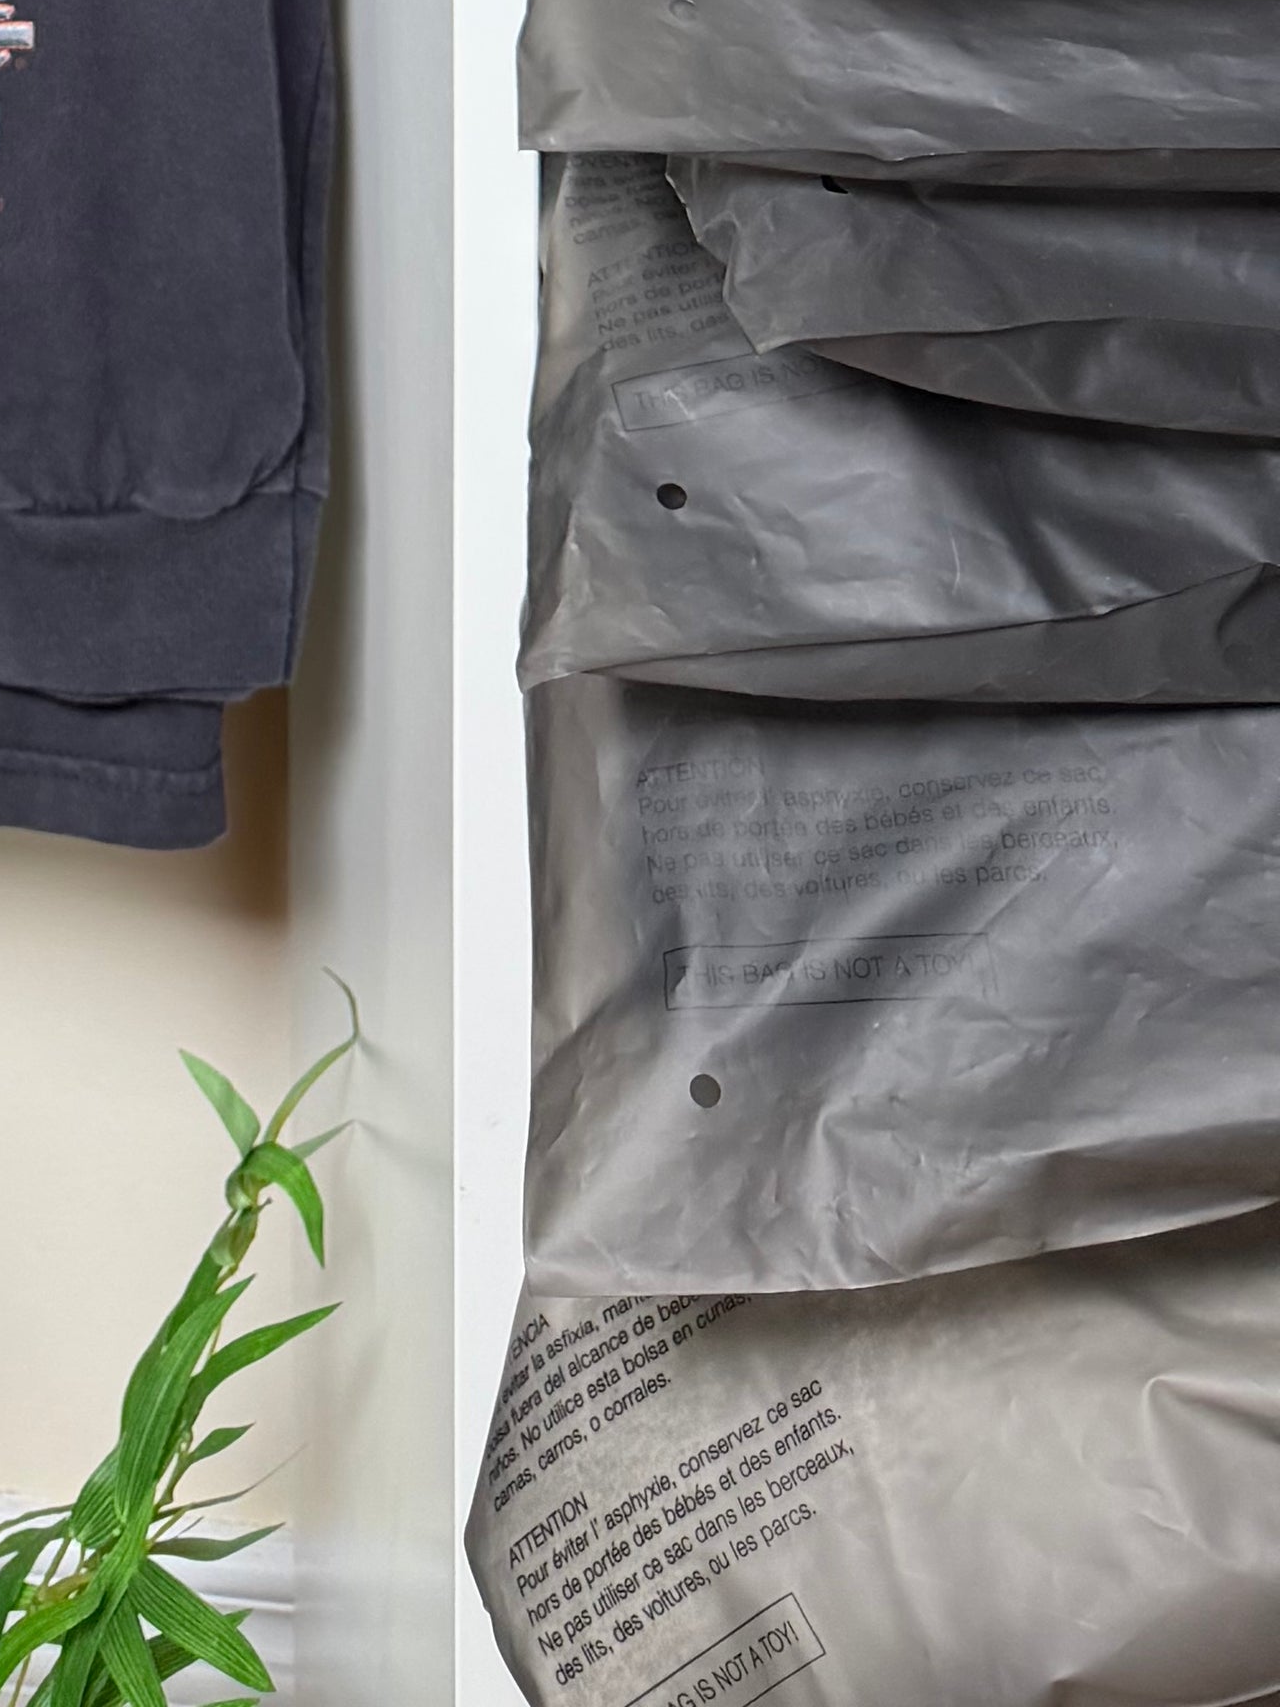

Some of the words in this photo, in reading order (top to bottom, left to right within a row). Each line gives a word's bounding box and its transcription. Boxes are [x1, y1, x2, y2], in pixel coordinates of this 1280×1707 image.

[597, 316, 626, 336] Ne
[633, 306, 671, 326] pas
[601, 333, 641, 352] des
[752, 366, 774, 385] IS
[815, 815, 857, 836] des
[863, 806, 935, 831] bébés
[941, 802, 961, 820] et
[1023, 795, 1116, 816] enfants.
[899, 769, 1015, 799] conservez
[1022, 766, 1052, 784] ce
[813, 848, 840, 865] ce
[848, 842, 887, 861] sac
[976, 863, 1049, 885] parcs.
[803, 960, 825, 980] IS
[834, 955, 883, 981] NOT
[895, 955, 911, 977] A
[510, 1394, 543, 1427] fuera
[543, 1373, 566, 1397] del
[566, 1333, 629, 1378] alcance
[632, 1311, 655, 1338] de
[520, 1424, 541, 1452] No
[543, 1391, 584, 1435] utilice
[587, 1371, 622, 1399] esta
[621, 1338, 669, 1378] bolsa
[671, 1323, 693, 1346] en
[695, 1294, 752, 1329] cunas,
[533, 1352, 545, 1373] la
[546, 1317, 600, 1360] asfixia,
[538, 1429, 588, 1471] carros,
[589, 1415, 601, 1433] o
[603, 1369, 672, 1422] corrales.
[516, 1561, 550, 1599] Pour
[553, 1531, 590, 1570] éviter
[604, 1473, 677, 1530] asphyxie,
[678, 1416, 765, 1479] conservez
[767, 1401, 789, 1425] ce
[790, 1378, 823, 1409] sac
[526, 1593, 562, 1628] hors
[562, 1576, 583, 1602] de
[583, 1539, 632, 1591] portée
[633, 1517, 663, 1548] des
[661, 1483, 717, 1527] bébés
[718, 1469, 738, 1492] et
[739, 1447, 773, 1479] des
[774, 1405, 842, 1458] enfants.
[508, 1491, 589, 1570] ATTENTION
[537, 1629, 564, 1658] Ne
[563, 1608, 593, 1644] pas
[592, 1571, 641, 1618] utiliser
[642, 1557, 664, 1581] ce
[664, 1536, 694, 1565] sac
[694, 1507, 738, 1544] dans
[737, 1489, 767, 1518] les
[765, 1438, 856, 1500] berceaux,
[555, 1656, 584, 1687] des
[581, 1640, 615, 1667] lits,
[612, 1614, 645, 1643] des
[642, 1568, 713, 1622] voitures,
[708, 1552, 731, 1576] ou
[729, 1532, 759, 1563] les
[759, 1499, 818, 1548] parcs.
[692, 1677, 718, 1704] IS
[711, 1652, 750, 1690] NOT
[747, 1645, 765, 1669] A
[759, 1619, 801, 1654] TOY!
